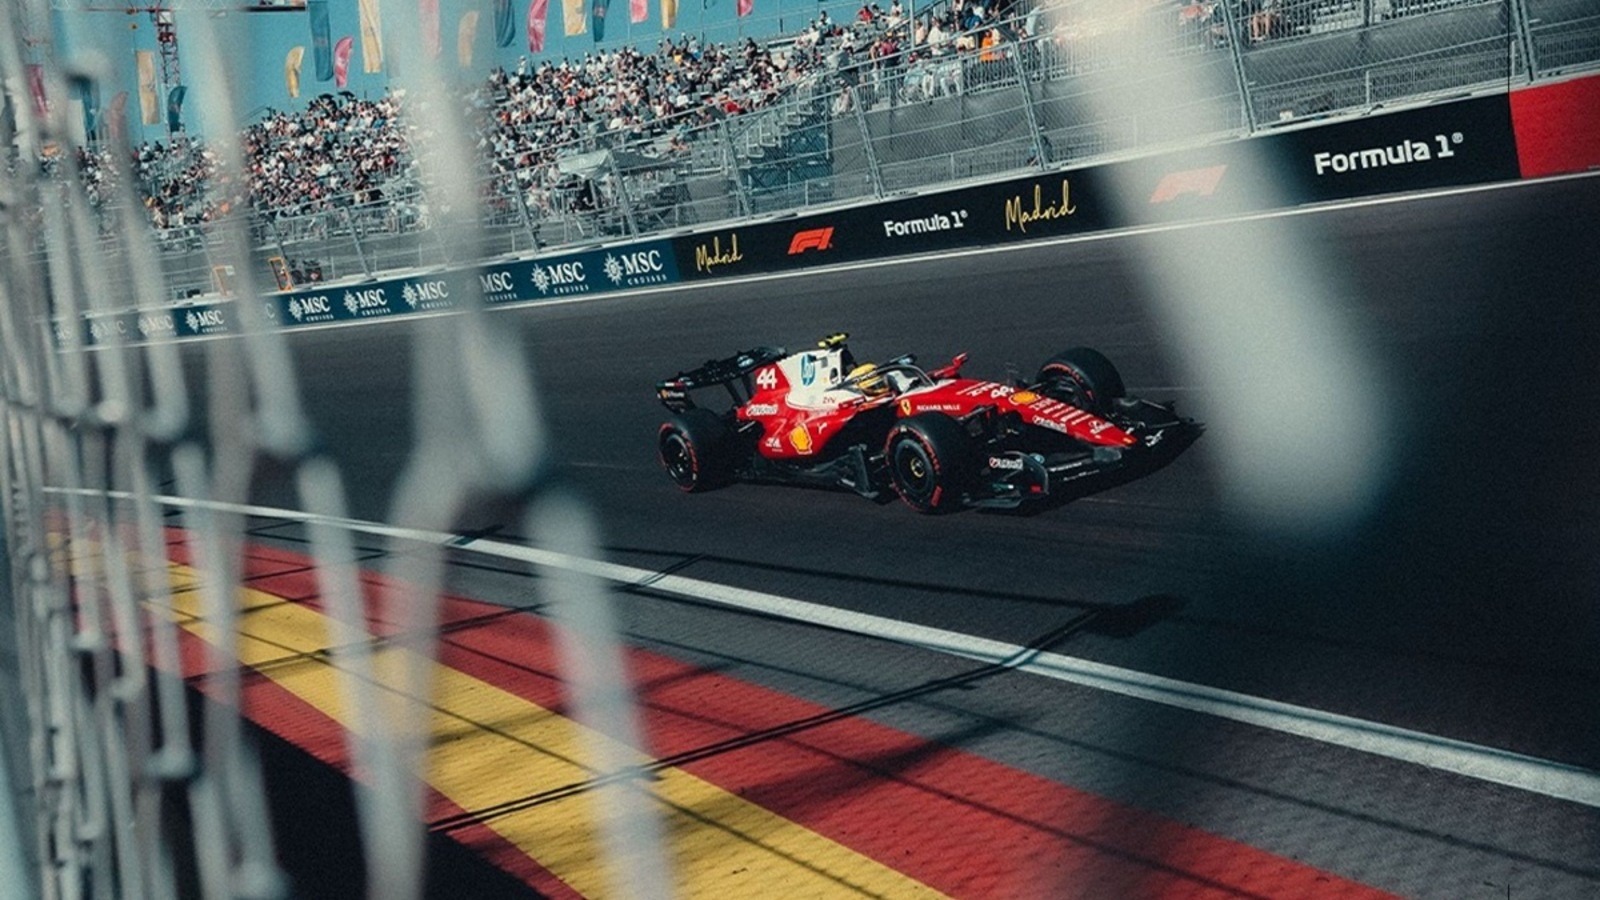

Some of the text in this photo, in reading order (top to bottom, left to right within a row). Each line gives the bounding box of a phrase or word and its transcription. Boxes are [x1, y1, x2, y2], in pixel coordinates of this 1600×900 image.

[1314, 140, 1431, 175] Formula
[1005, 179, 1076, 233] Madrid
[883, 213, 950, 237] Formula
[621, 250, 663, 275] MSC
[696, 233, 743, 274] Madrid
[480, 272, 513, 293] MSC
[548, 262, 586, 284] MSC
[627, 274, 667, 286] CRUISES
[356, 288, 387, 307] MSC
[416, 280, 449, 300] MSC
[301, 296, 331, 314] MSC
[196, 309, 225, 326] MSC
[756, 368, 778, 390] 44
